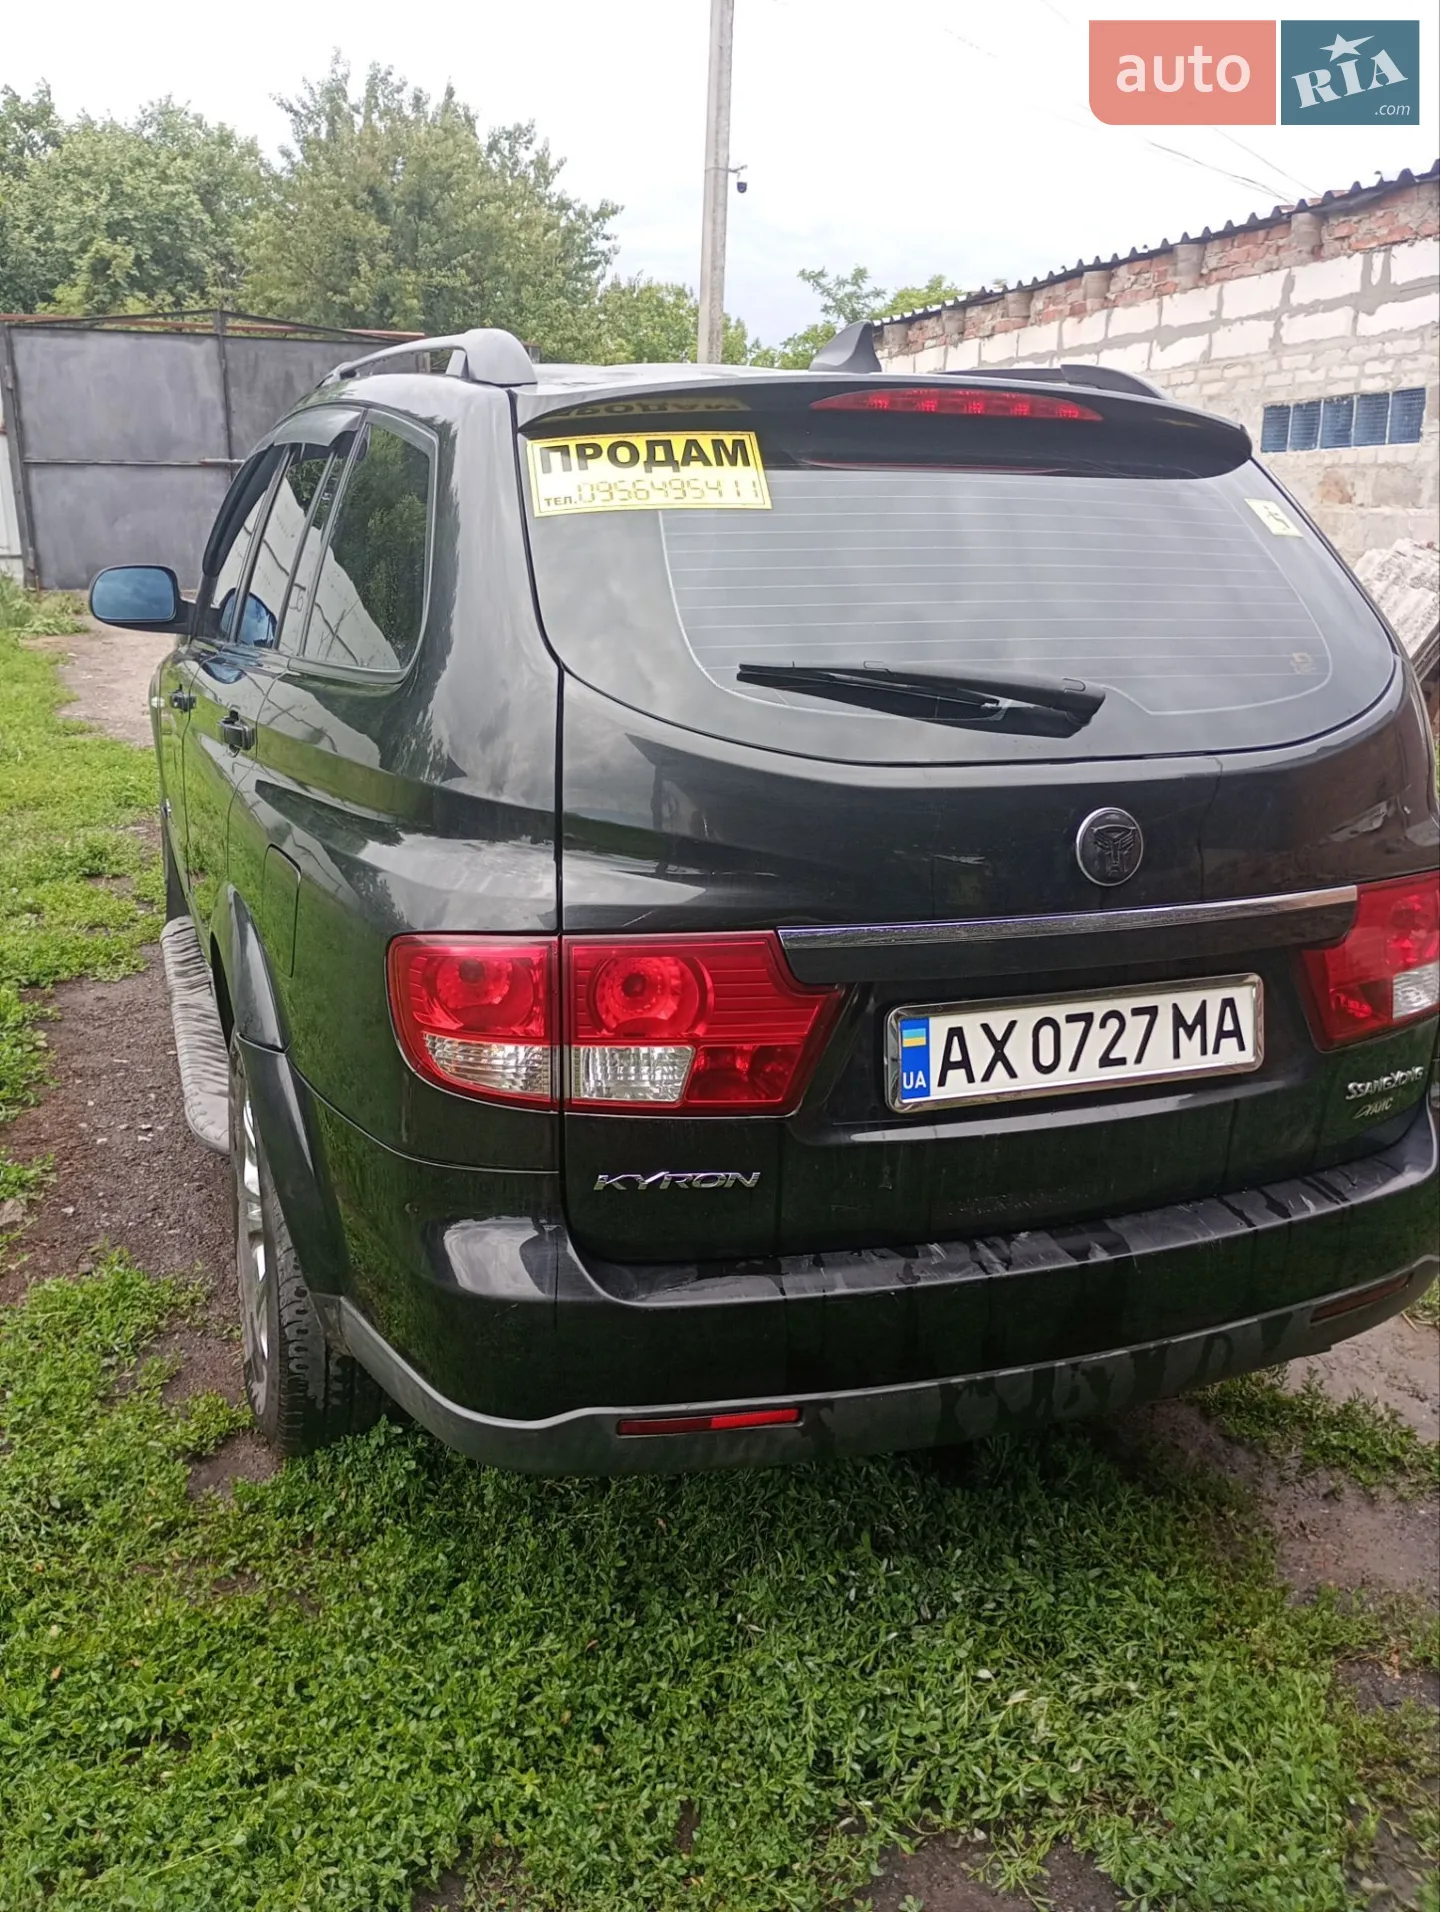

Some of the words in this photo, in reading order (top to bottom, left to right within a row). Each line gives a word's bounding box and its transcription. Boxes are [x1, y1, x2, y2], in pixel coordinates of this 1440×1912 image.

[539, 438, 751, 475] ПРОДАМ
[902, 1073, 927, 1090] UA
[936, 1019, 1019, 1088] AX
[1030, 1004, 1159, 1075] 0727
[1172, 997, 1246, 1059] MA
[593, 1170, 761, 1190] KYRON
